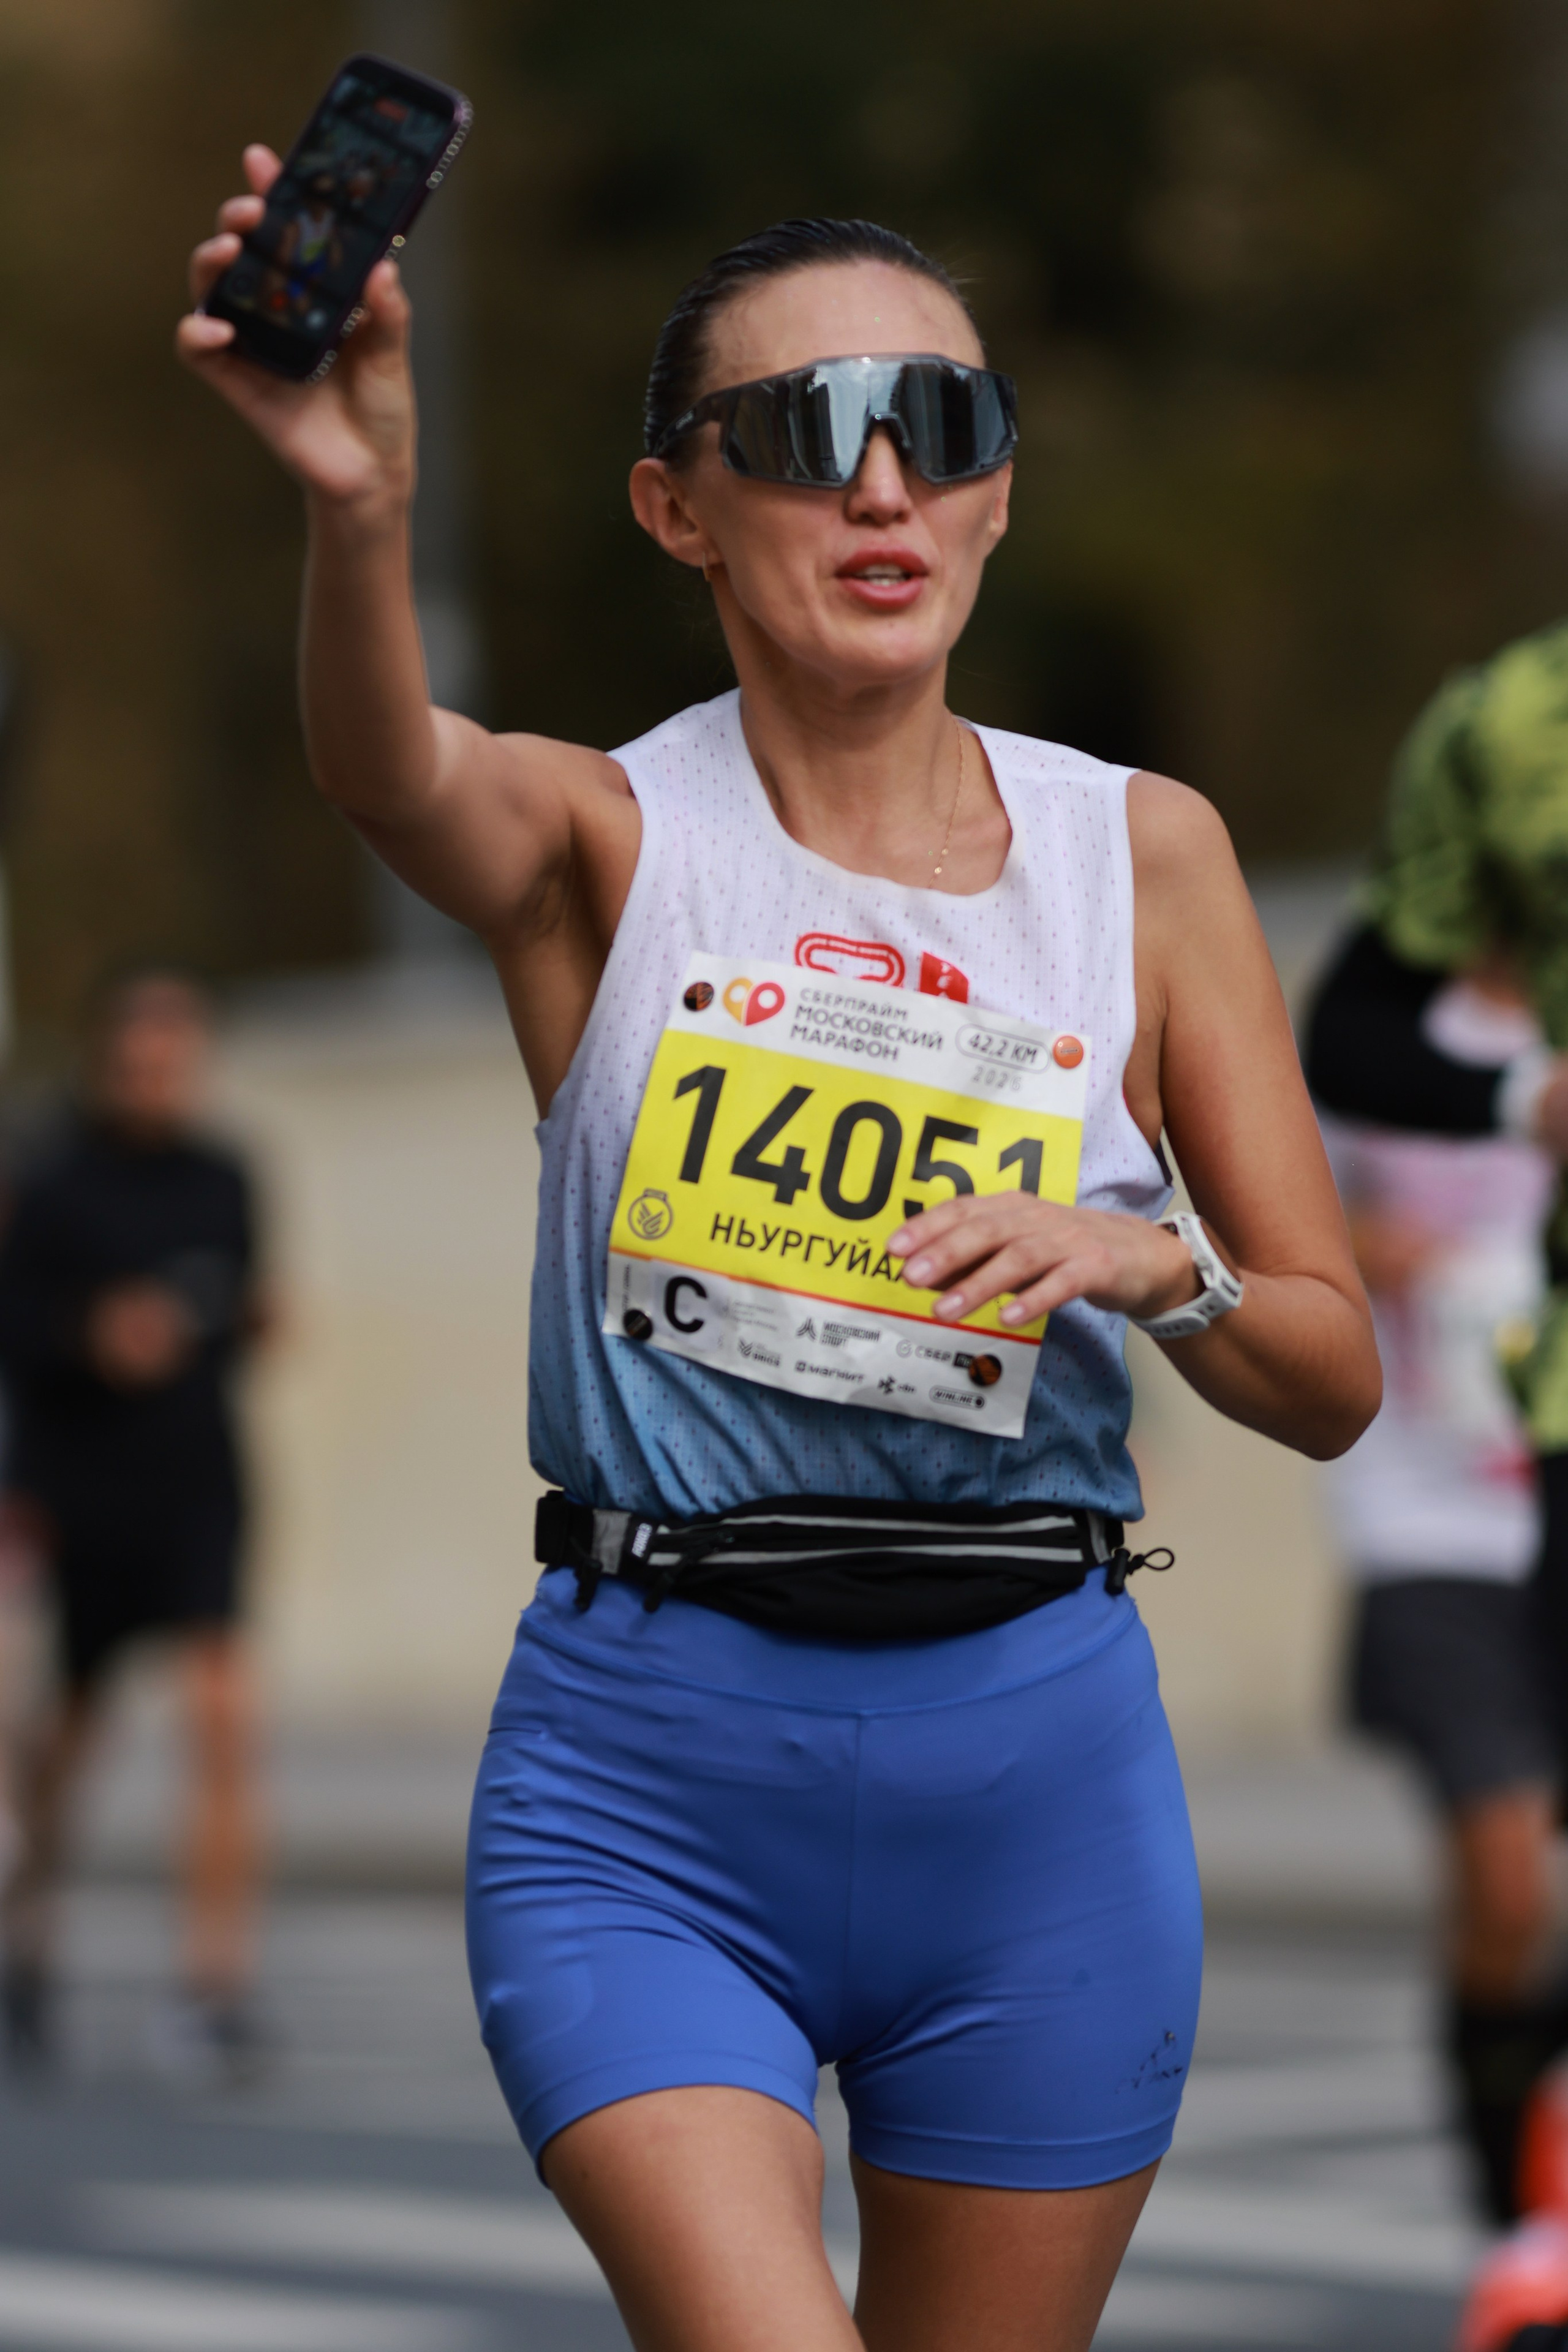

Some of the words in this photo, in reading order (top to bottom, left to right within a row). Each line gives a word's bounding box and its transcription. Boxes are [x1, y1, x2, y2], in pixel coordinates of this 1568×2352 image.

[799, 987, 908, 1021] СБЕРПРАЙМ
[790, 1024, 899, 1061] МАРАФОН
[795, 1005, 944, 1050] МОСКОВСКИЙ
[968, 1034, 1009, 1057] 42,2
[673, 1064, 1044, 1221] 14051
[709, 1213, 905, 1282] НЬУРГУЙА
